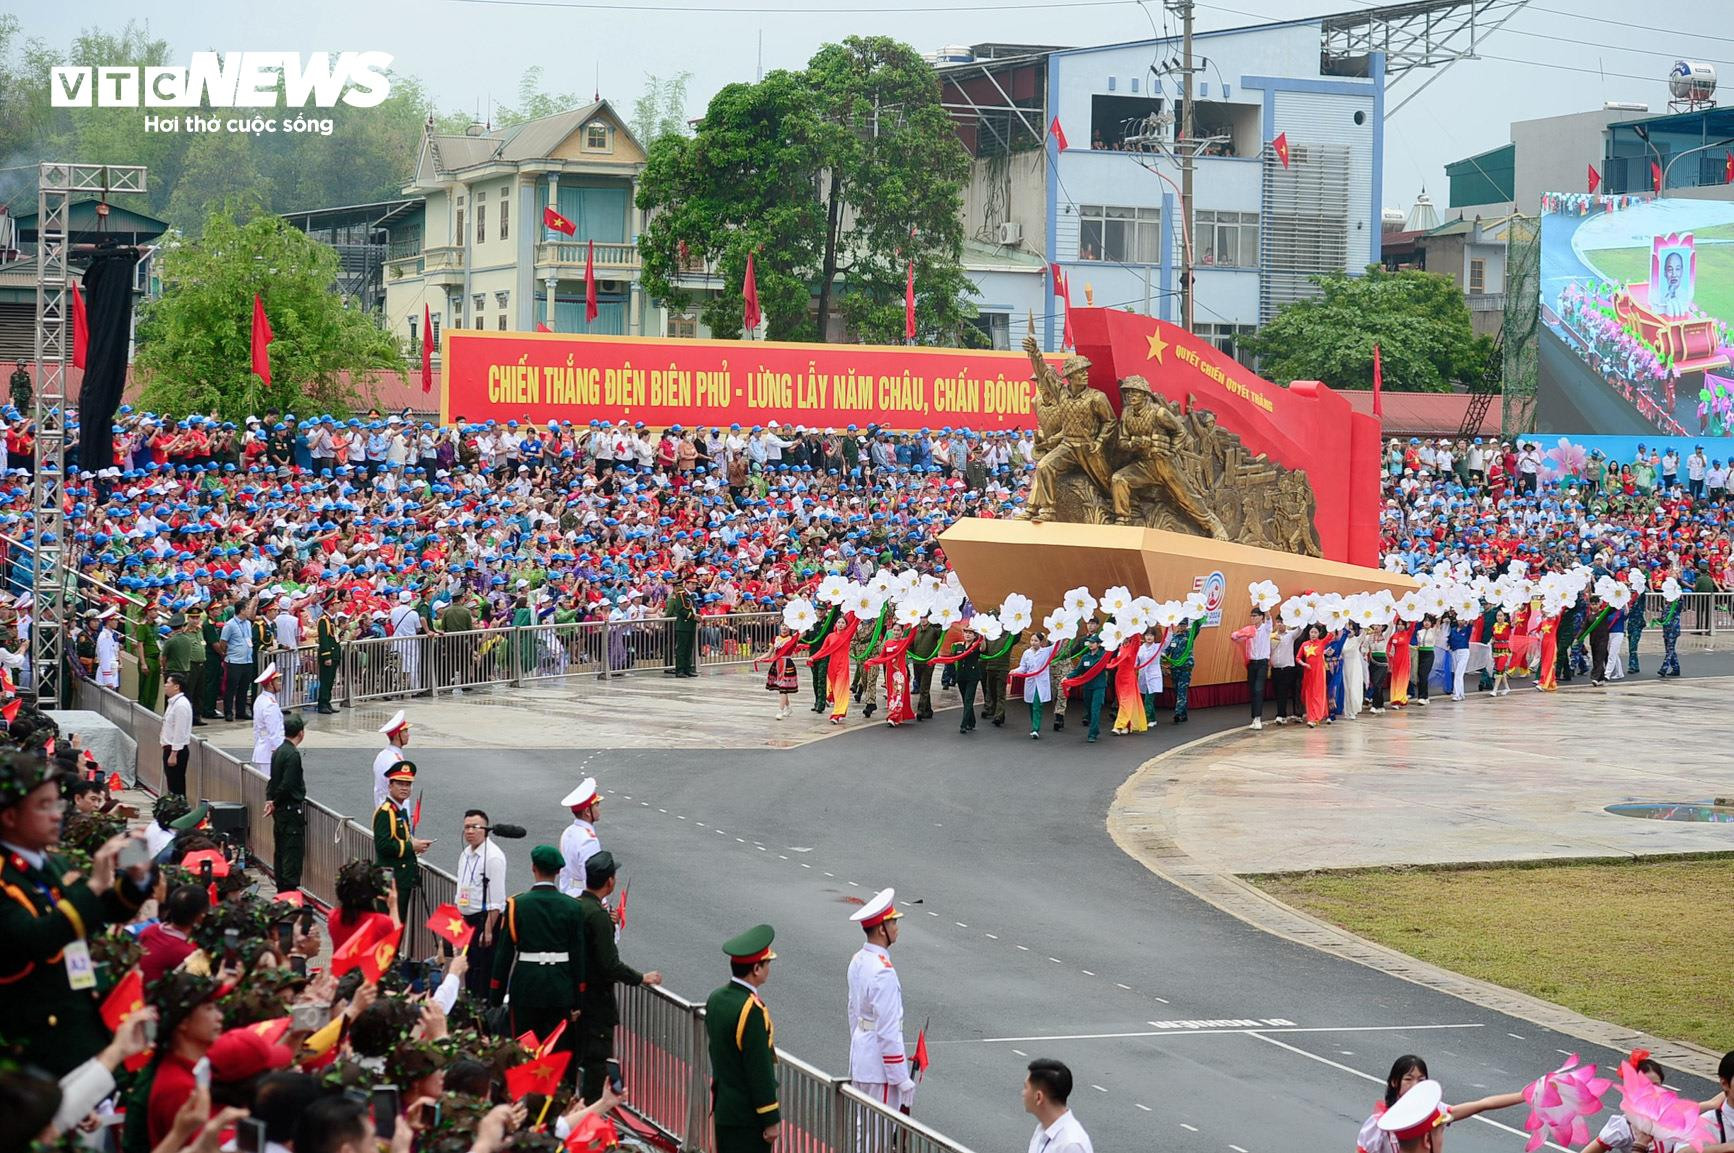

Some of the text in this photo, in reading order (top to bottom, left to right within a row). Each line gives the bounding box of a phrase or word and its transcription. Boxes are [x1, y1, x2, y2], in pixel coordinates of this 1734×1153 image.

[488, 353, 539, 404] CHIẾN
[544, 353, 600, 405] THẮNG
[604, 361, 646, 414] ĐIỆN
[650, 363, 691, 407] BIÊN
[696, 359, 731, 408] PHỦ
[747, 365, 792, 409] LỪNG
[797, 361, 828, 409] LẪY
[833, 368, 873, 410] NĂM
[878, 369, 929, 416] CHÂU,
[933, 367, 979, 413] CHẤN
[984, 373, 1030, 422] ĐỘNG
[1175, 344, 1273, 413] QUYẾT CHIẾN QUYẾT THẮNG
